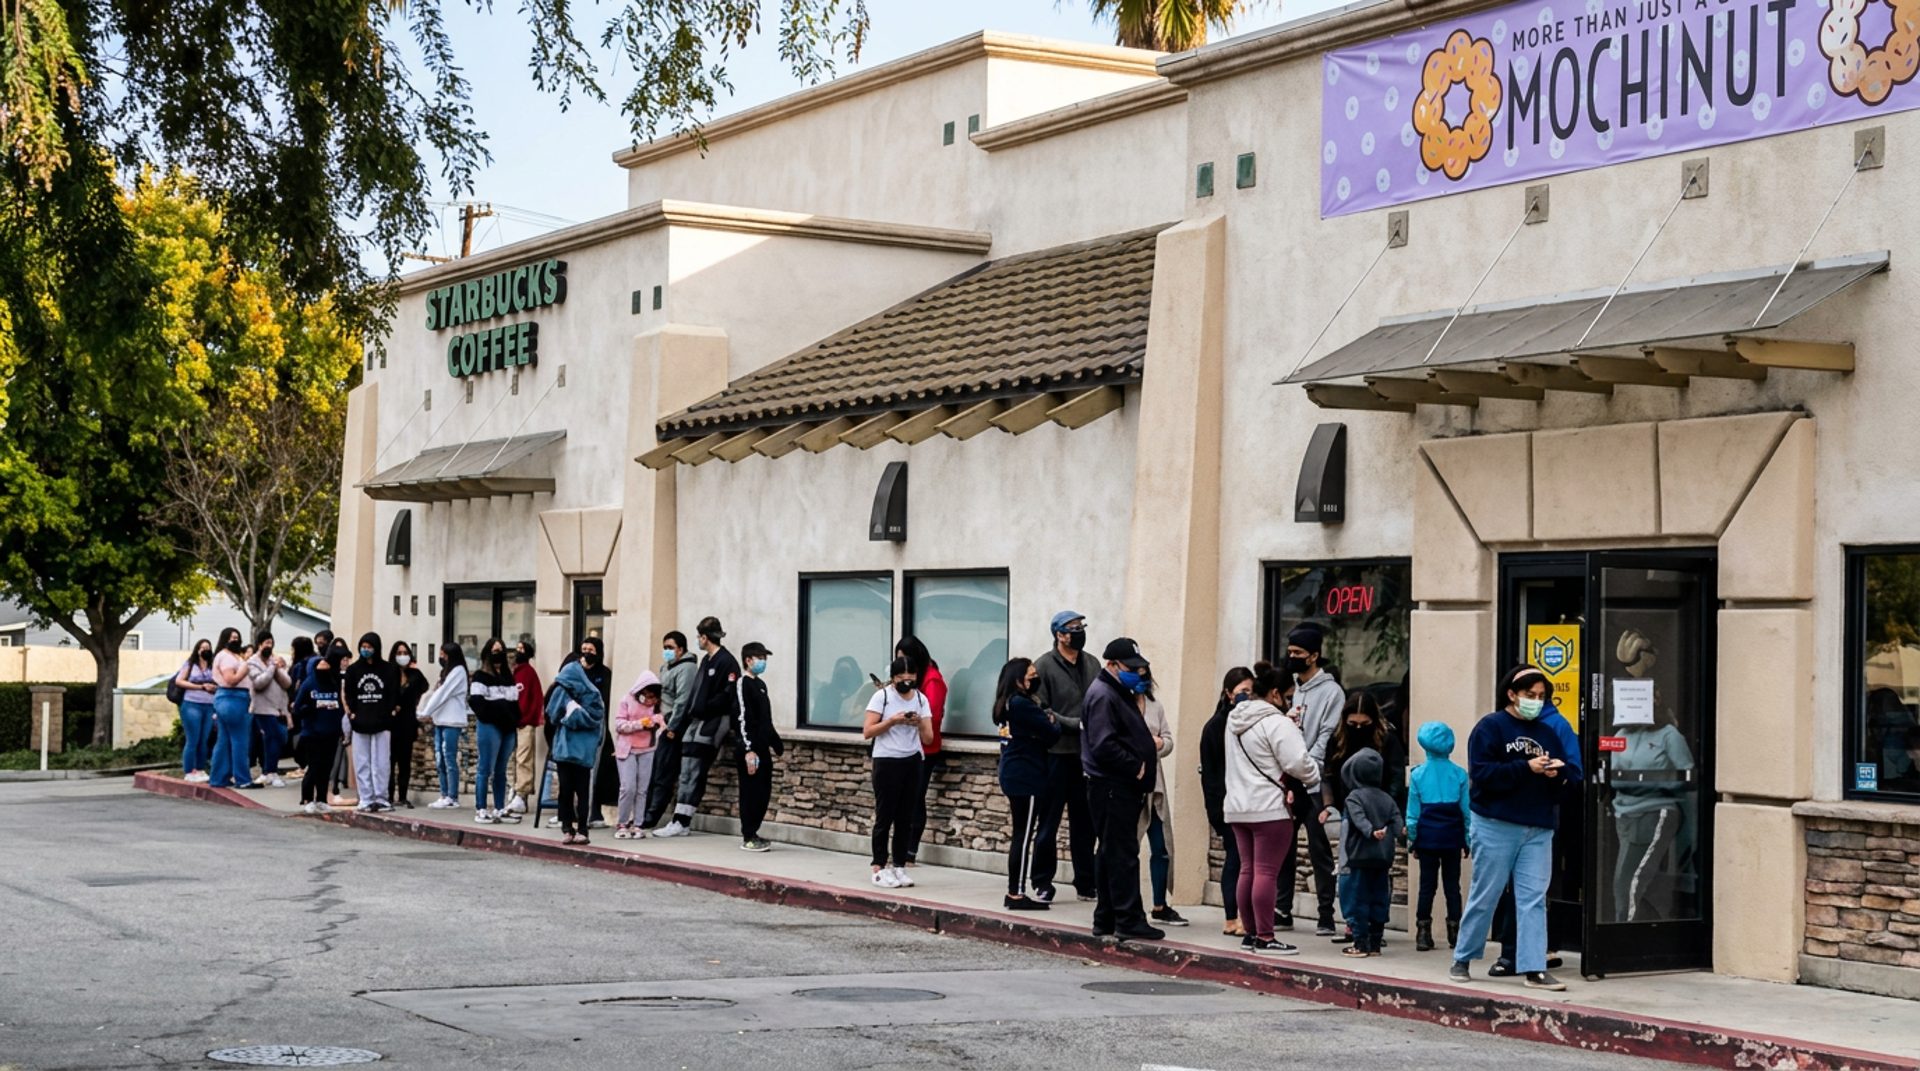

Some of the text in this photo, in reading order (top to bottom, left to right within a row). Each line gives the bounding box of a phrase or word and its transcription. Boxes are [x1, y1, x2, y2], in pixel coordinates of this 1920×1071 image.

[1512, 21, 1565, 51] MORE
[1574, 6, 1627, 37] THAN
[1506, 0, 1796, 150] MOCHINUT
[425, 259, 561, 331] STARBUCKS
[448, 322, 532, 378] COFFEE
[1326, 585, 1374, 615] OPEN
